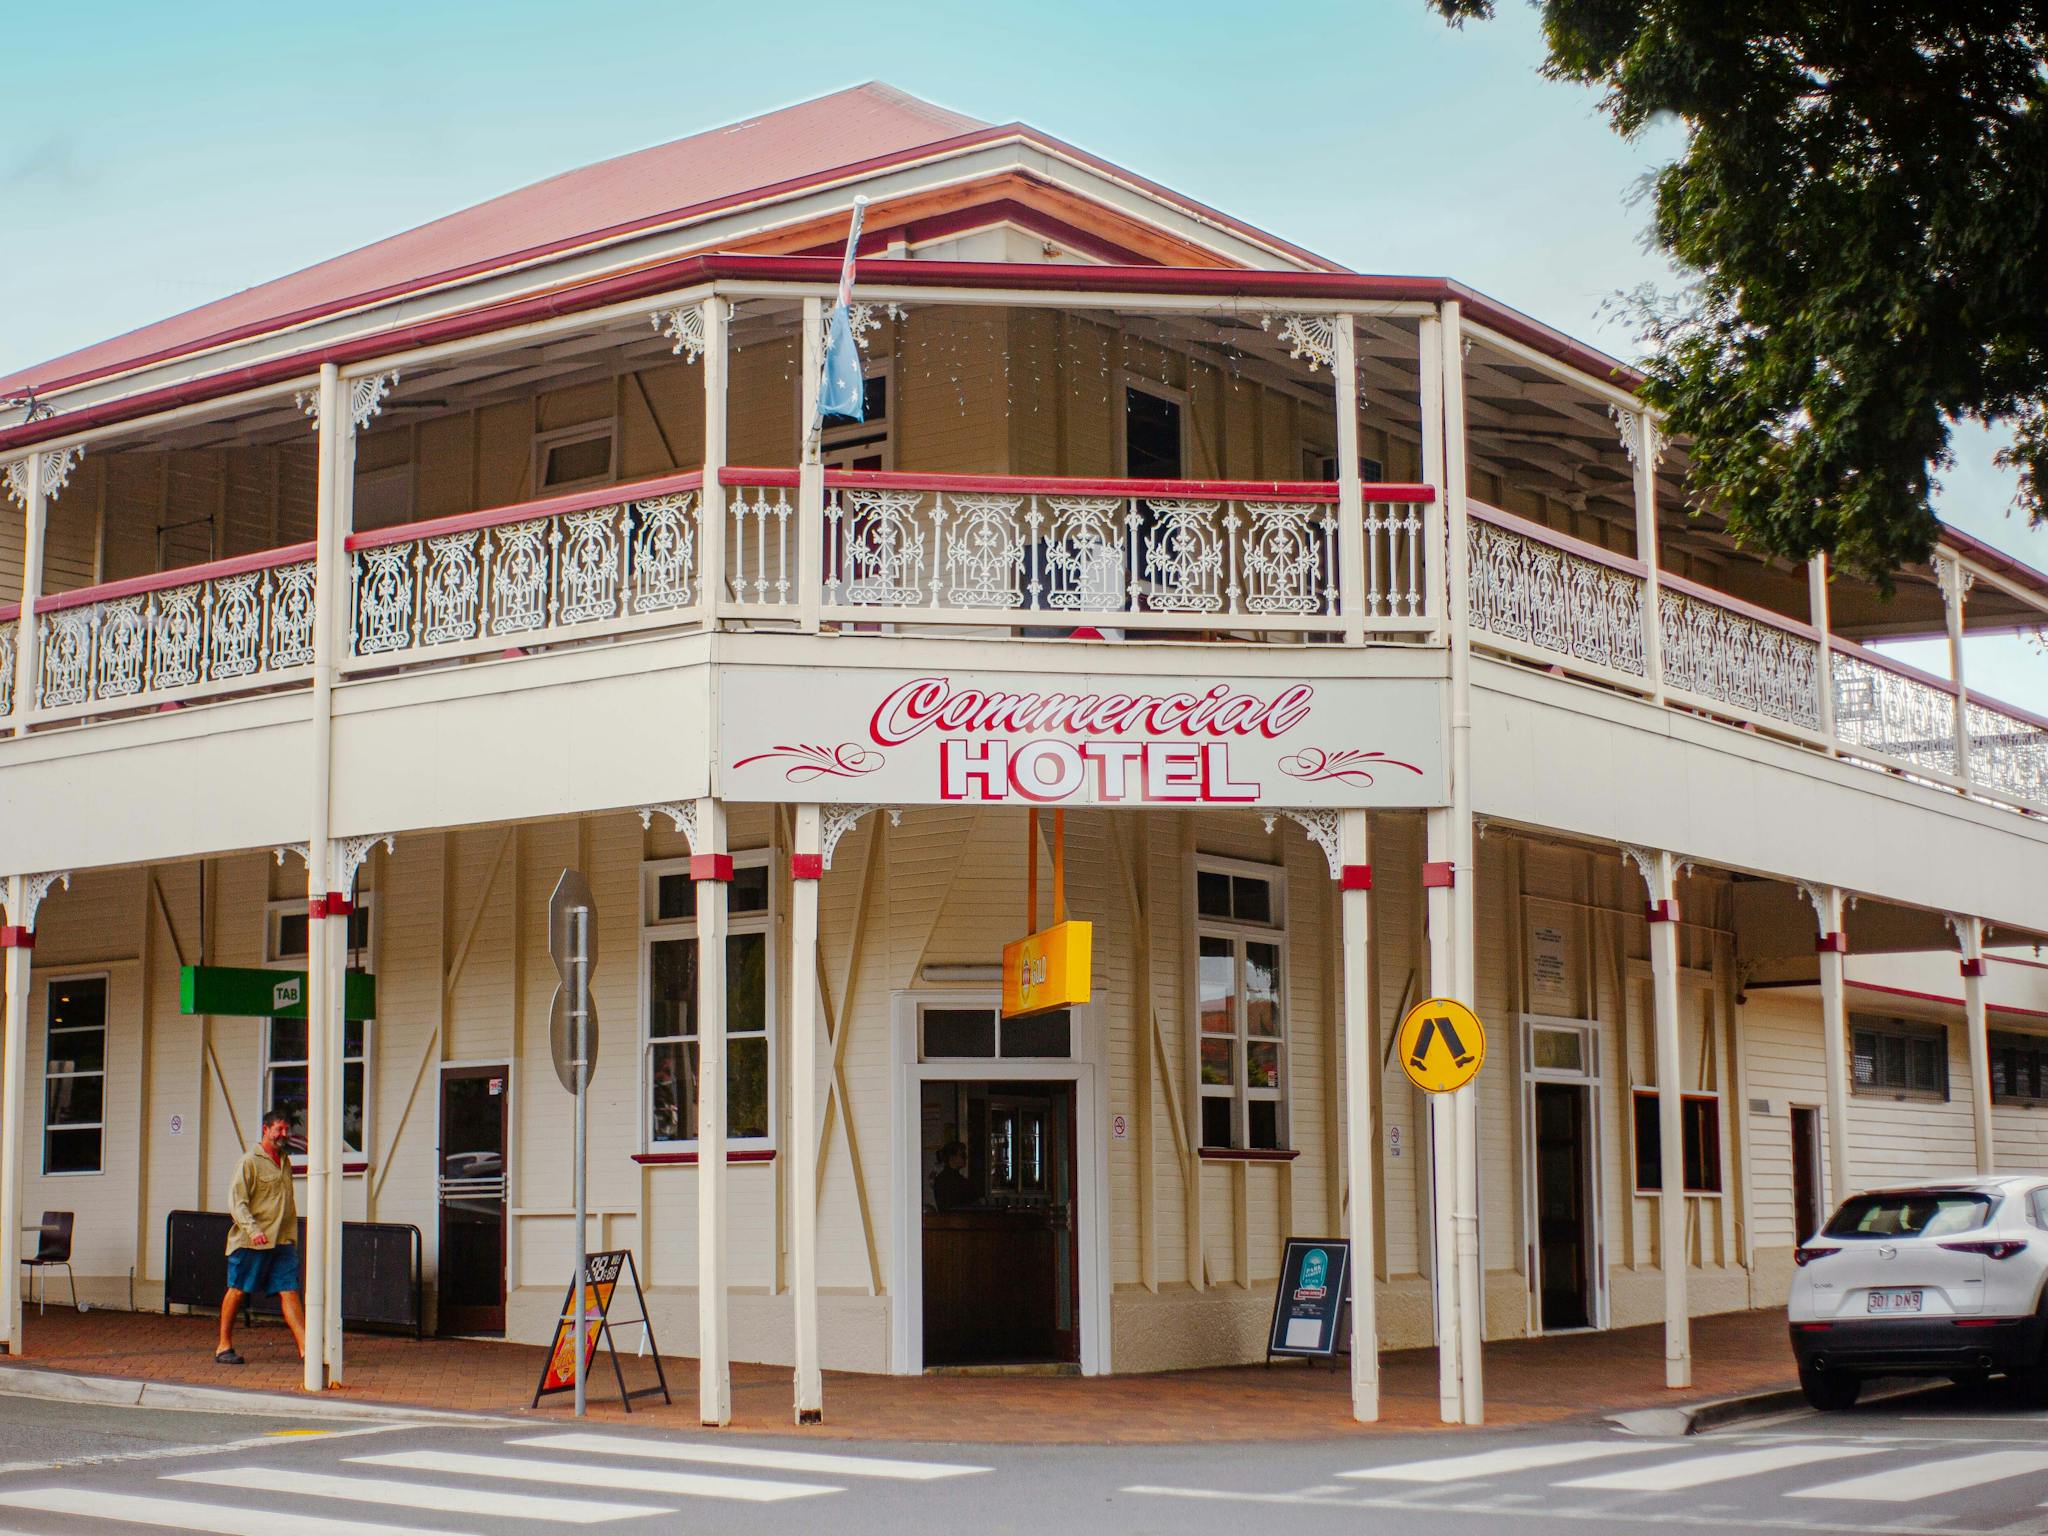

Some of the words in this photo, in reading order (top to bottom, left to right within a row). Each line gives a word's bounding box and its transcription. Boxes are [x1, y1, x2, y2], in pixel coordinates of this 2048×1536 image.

[869, 677, 1314, 747] Commercial
[940, 738, 1261, 802] HOTEL
[275, 987, 298, 1001] TAB
[1870, 1295, 1889, 1307] 301
[1895, 1294, 1920, 1307] DN9
